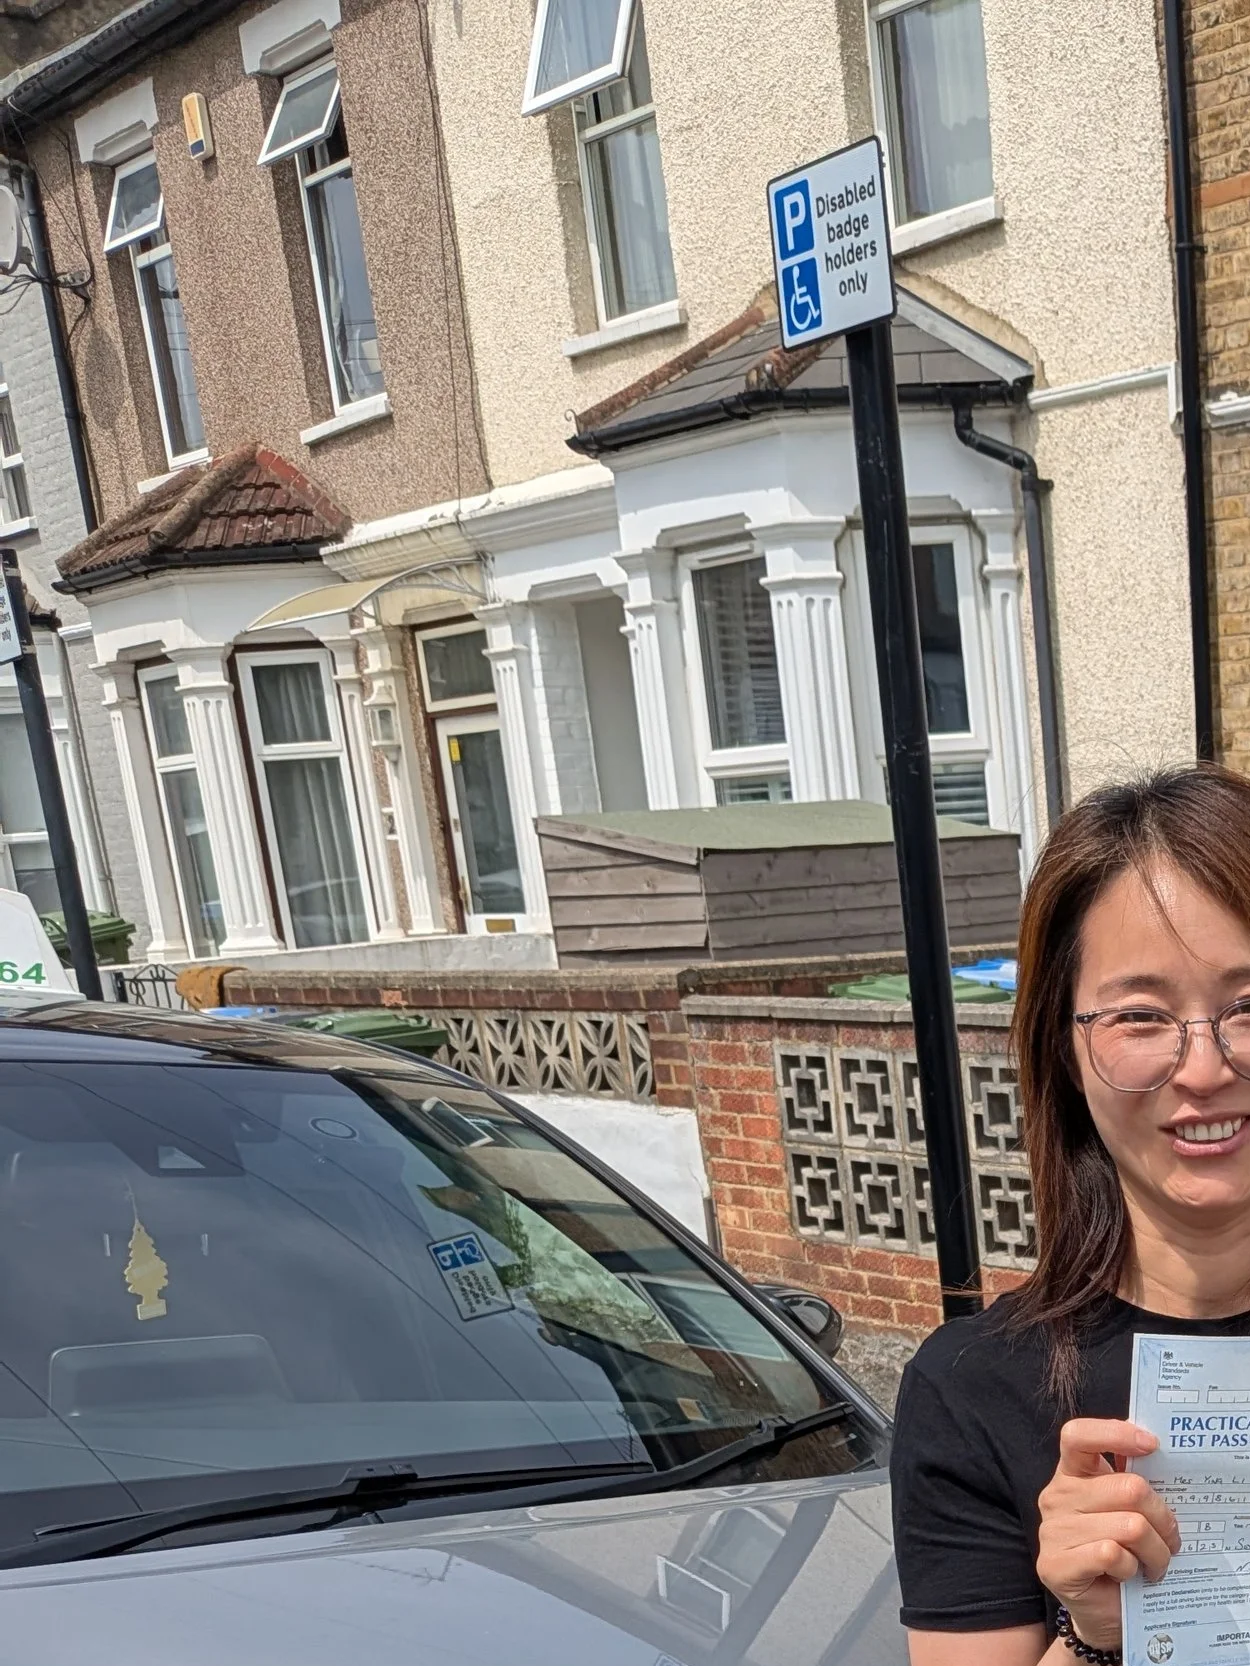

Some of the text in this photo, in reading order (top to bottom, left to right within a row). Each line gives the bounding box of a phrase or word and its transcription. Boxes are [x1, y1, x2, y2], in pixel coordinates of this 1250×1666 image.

[815, 175, 876, 218] Disabled
[783, 190, 806, 251] P
[827, 213, 870, 243] badge
[824, 239, 877, 273] holders
[839, 270, 869, 297] only
[0, 961, 46, 984] 64
[1170, 1434, 1206, 1448] TEST
[1211, 1433, 1248, 1447] PASS
[1204, 1522, 1212, 1531] B
[1143, 1591, 1170, 1599] Applicant's
[1171, 1588, 1200, 1596] Declaration
[1144, 1622, 1171, 1631] Applicant's
